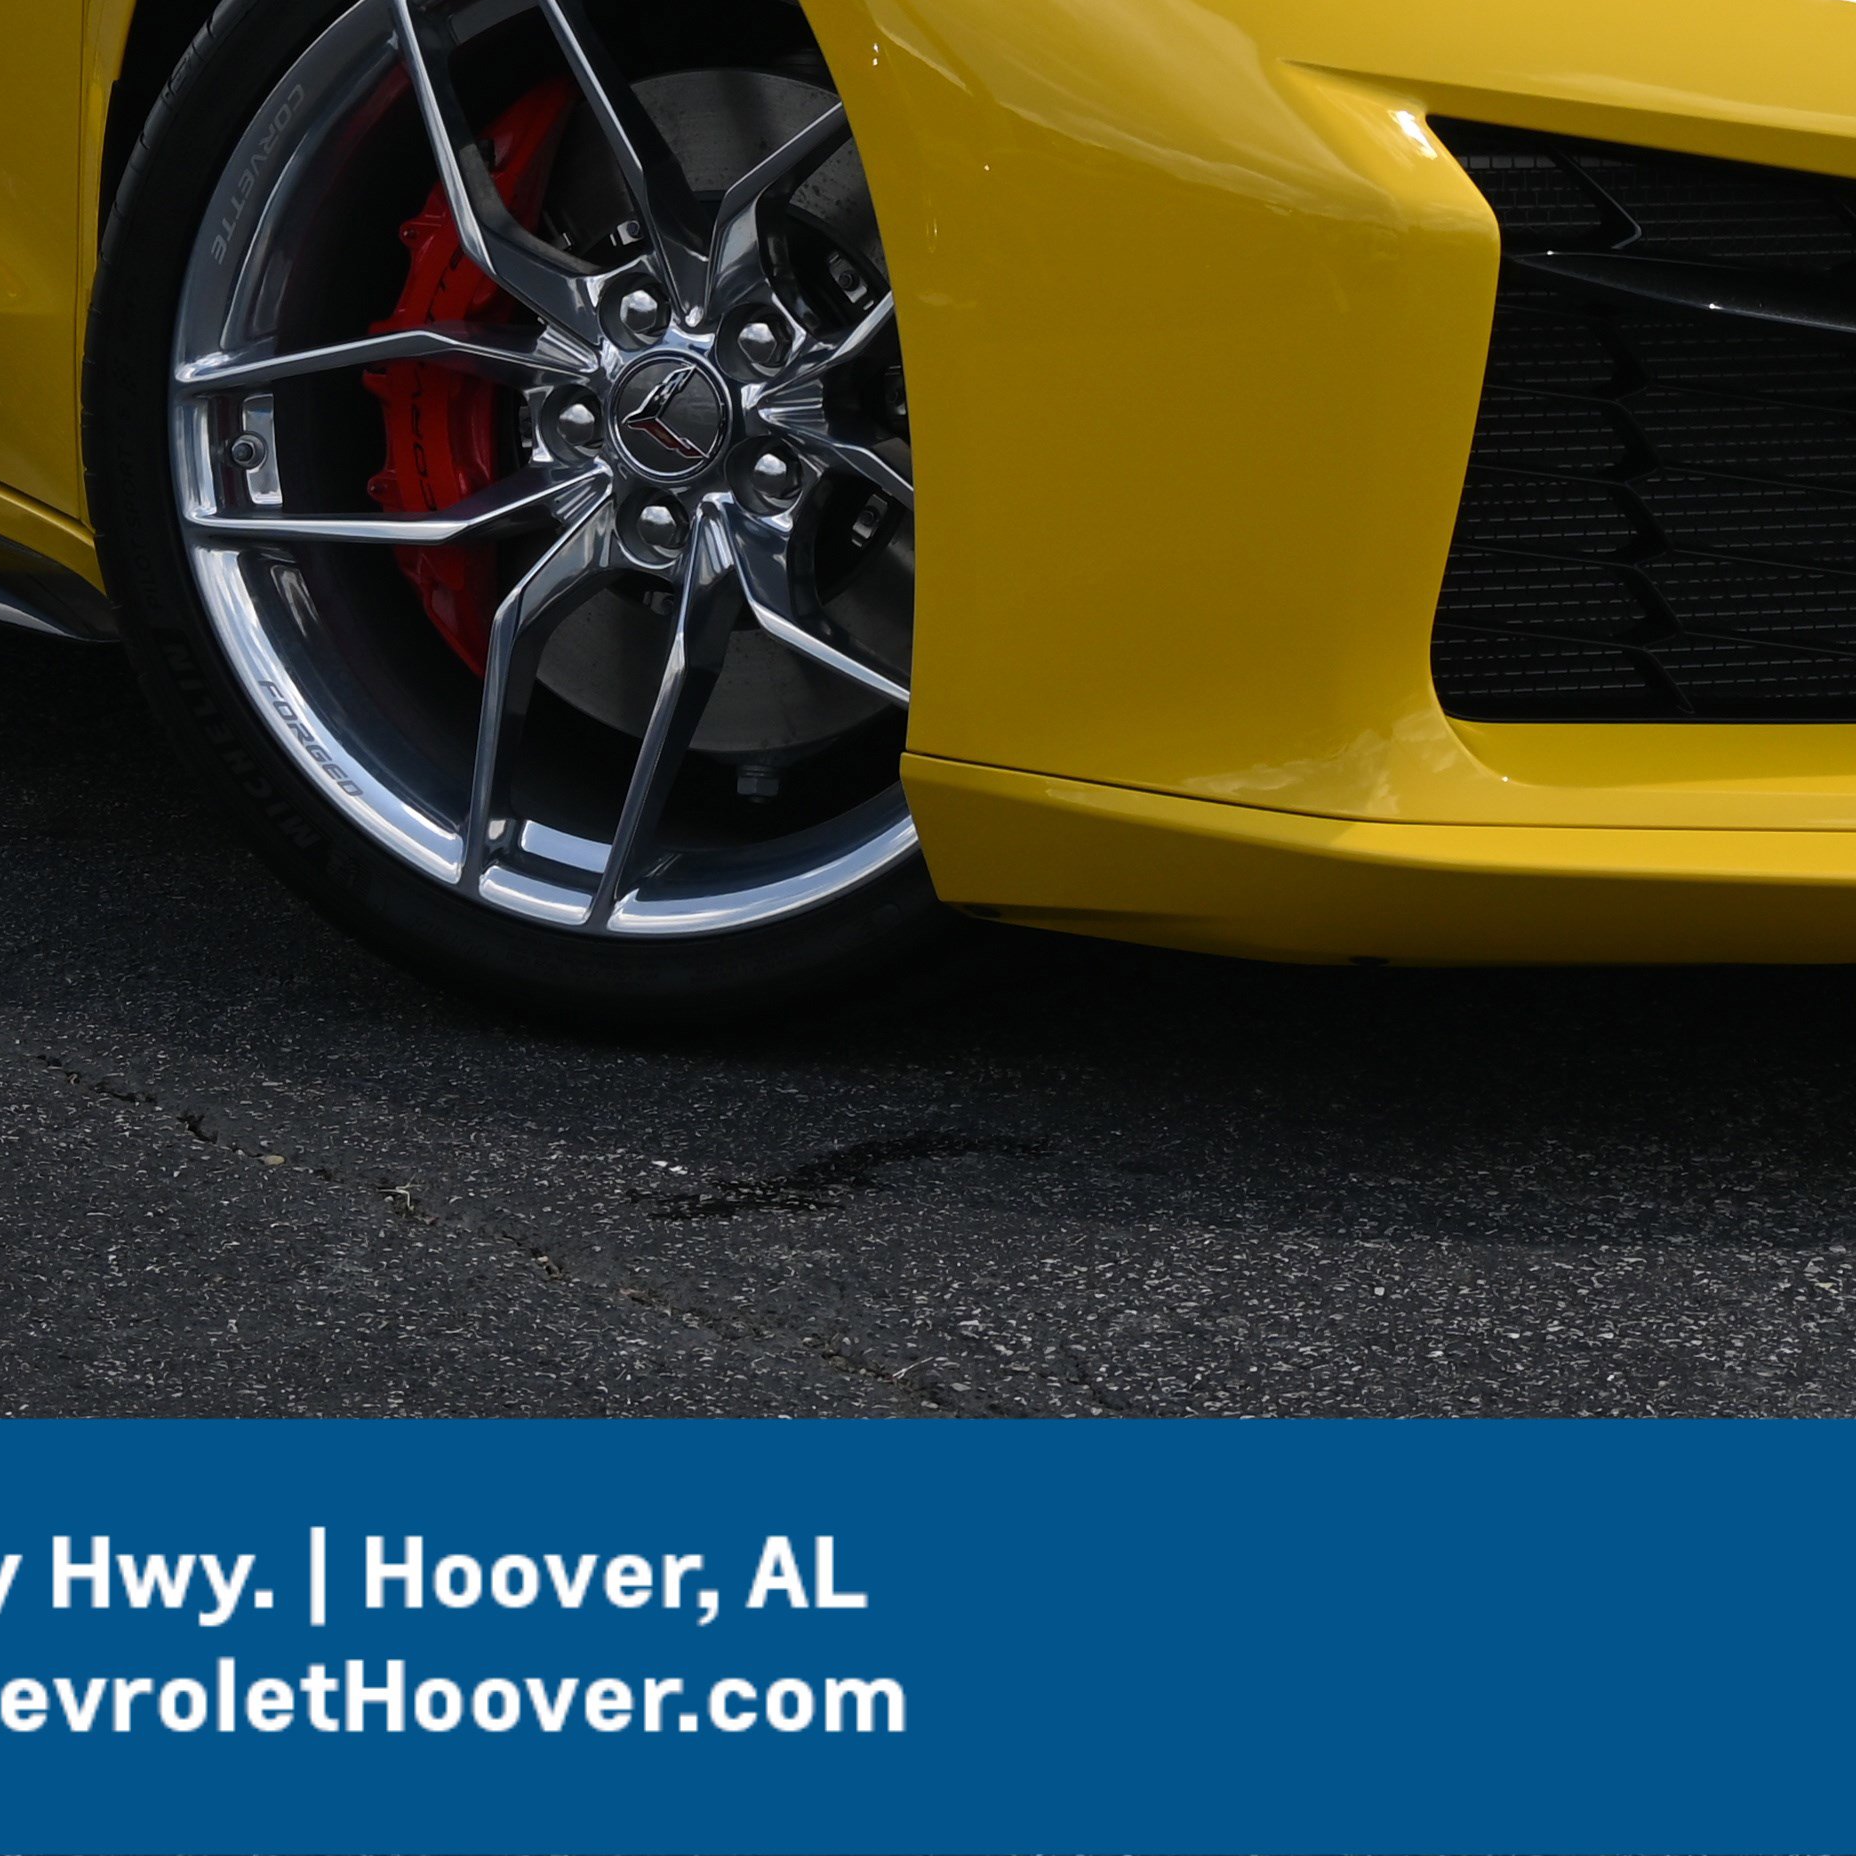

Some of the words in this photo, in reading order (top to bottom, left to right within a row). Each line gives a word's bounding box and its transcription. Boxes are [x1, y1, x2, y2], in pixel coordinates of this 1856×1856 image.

[210, 83, 305, 265] CORVETTE
[161, 643, 322, 849] MICHELIN
[258, 680, 364, 796] FORGED
